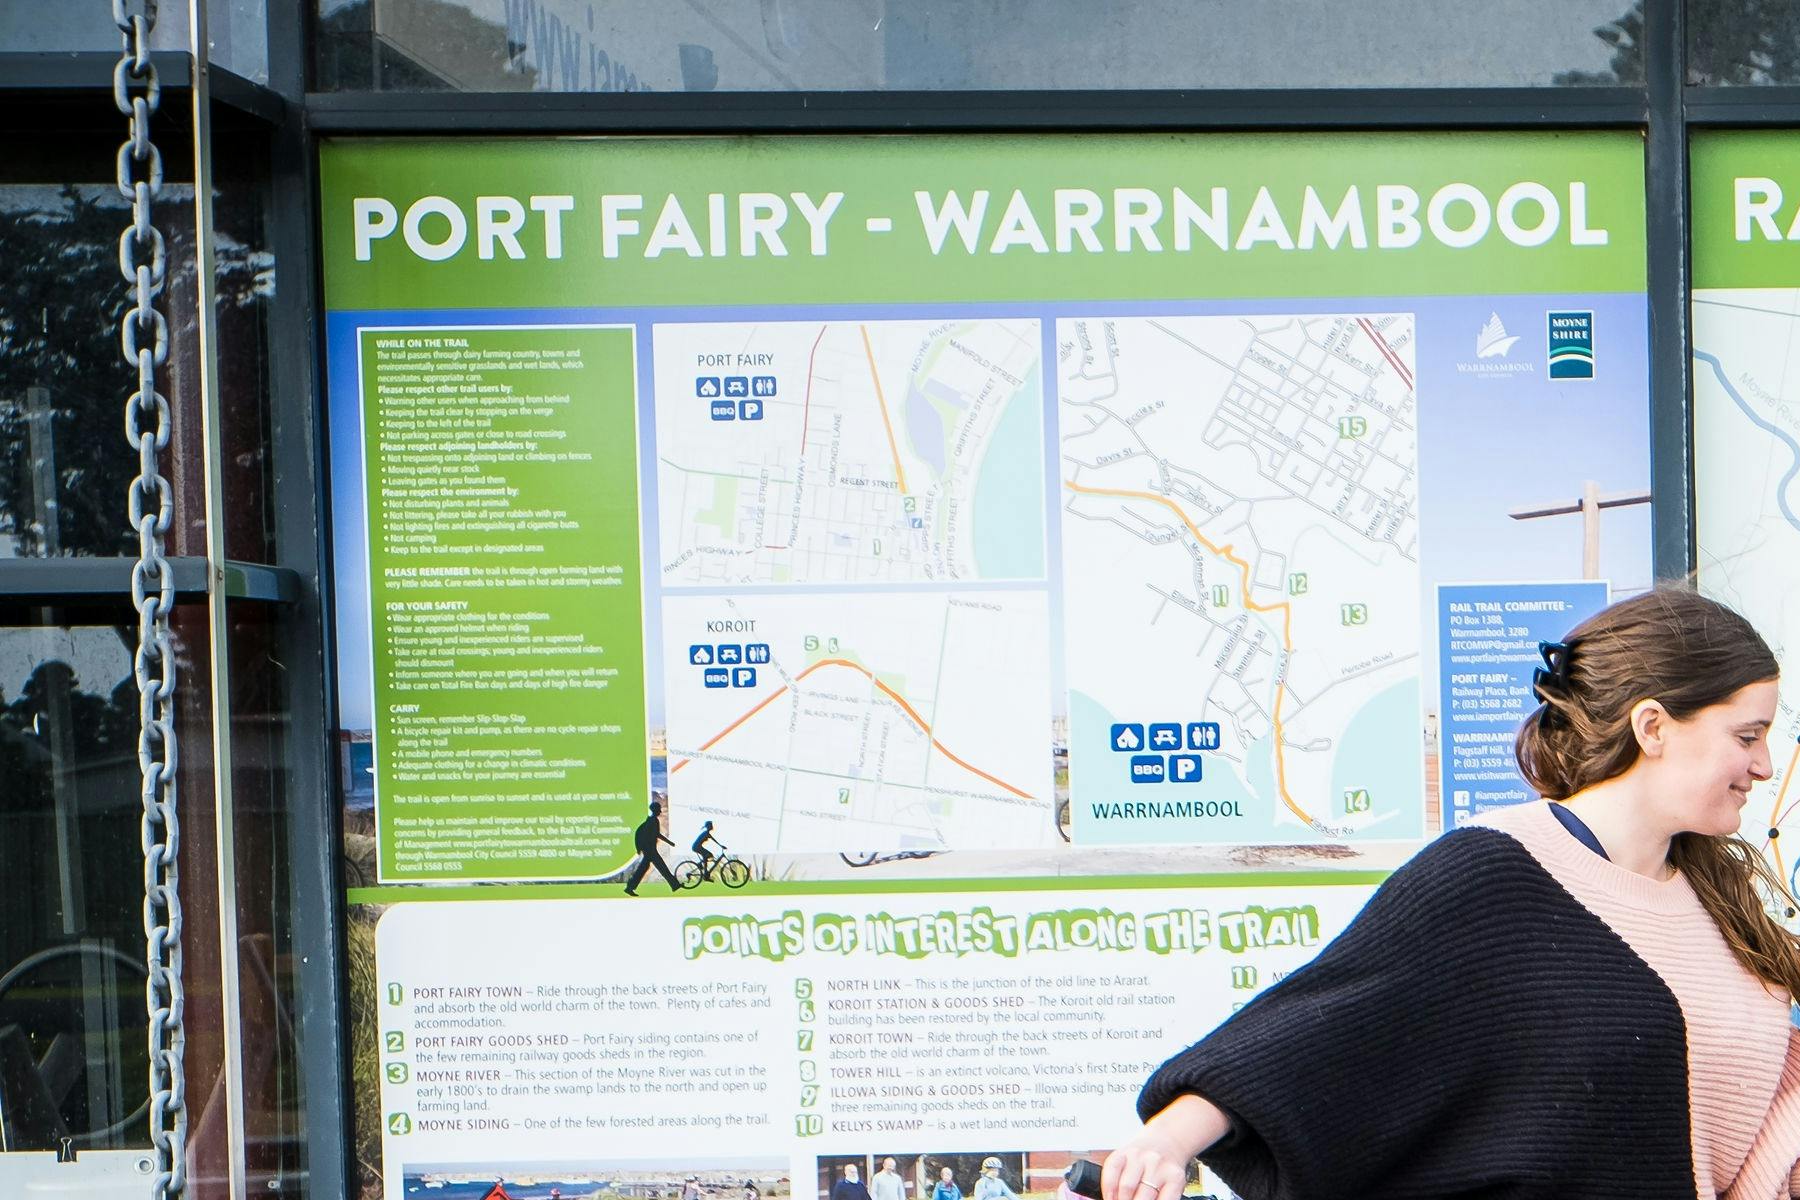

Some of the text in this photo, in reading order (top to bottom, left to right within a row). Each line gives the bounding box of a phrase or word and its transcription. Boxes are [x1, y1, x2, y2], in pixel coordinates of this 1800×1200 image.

[352, 195, 574, 262] PORT
[600, 191, 845, 259] FAIRY
[914, 181, 1609, 256] WARRNAMBOOL
[1552, 318, 1588, 328] MOYNE
[1552, 330, 1588, 340] SHIRE
[375, 338, 469, 349] WHILE ON THE TRAIL
[697, 353, 774, 367] PORT FAIRY
[1456, 361, 1535, 373] WARRNAMBOOL
[712, 405, 735, 416] BBQ
[745, 403, 759, 418] P
[1339, 416, 1367, 439] 15
[384, 566, 471, 577] PLEASE REMEMBER
[385, 600, 468, 612] FOR YOUR SAFETY
[1449, 600, 1565, 613] RAIL TRAIL COMMITTEE
[1341, 603, 1368, 626] 13
[1449, 614, 1504, 625] PO Box 1388,
[706, 620, 757, 633] KOROIT
[706, 673, 728, 683] BBQ
[738, 670, 753, 686] P
[1451, 672, 1509, 684] PORT FAIRY
[389, 703, 420, 713] CARRY
[1132, 763, 1164, 776] BBQ
[1177, 758, 1196, 780] P
[1344, 789, 1370, 814] 14
[1091, 800, 1244, 819] WARRNAMBOOL
[683, 905, 1320, 962] POINTS OF INTEREST ALONG THE TRAIL
[388, 981, 767, 1006] 1 PORT FAIRY TOWN Ride through the back streets of Port Fairy
[795, 975, 1148, 999] 5 NORTH LINK This is the junction of the old line to Ararat.
[413, 1017, 505, 1028] accommodation.
[386, 1030, 759, 1053] 2 PORT FAIRY GOODS SHED Port Fairy siding contains one of
[388, 1112, 770, 1135] 4 MOYNE SIDING One of the few forested areas along the trail.
[795, 1114, 1079, 1137] 10 KELLYS SWAMP is a wet land wonderland.
